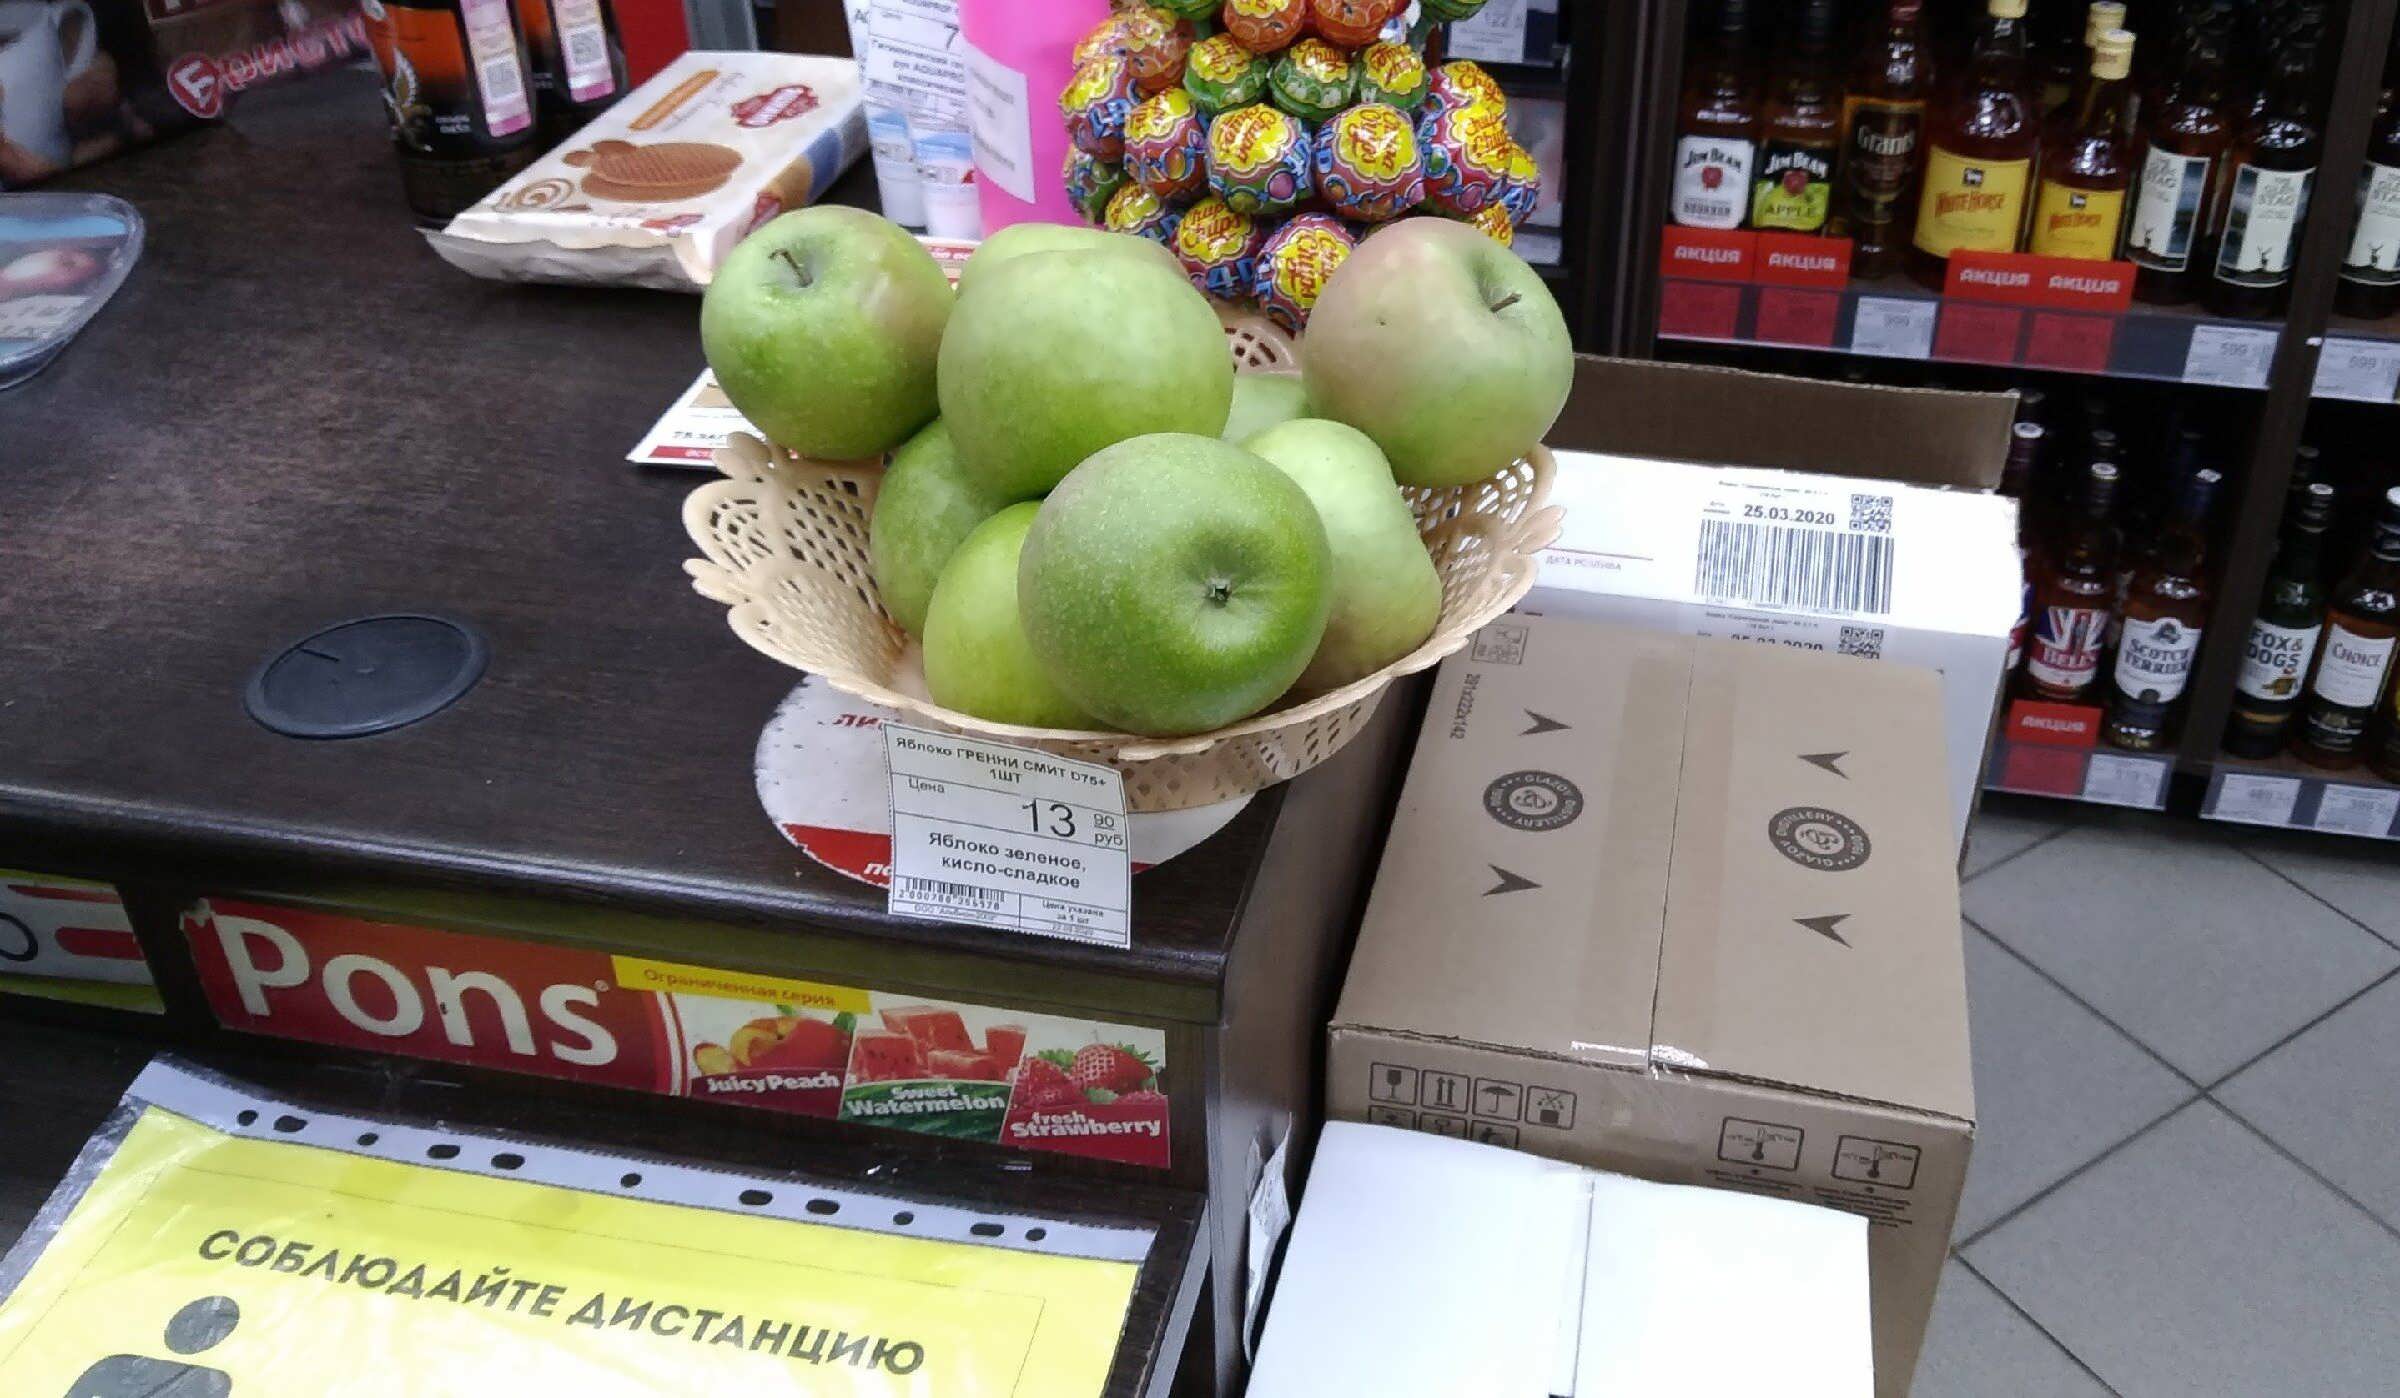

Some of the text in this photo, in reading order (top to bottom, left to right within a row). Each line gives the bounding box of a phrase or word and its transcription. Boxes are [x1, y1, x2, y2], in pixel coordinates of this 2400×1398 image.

[1673, 245, 1742, 264] АКЦИЯ
[1768, 252, 1836, 271] АКЦИЯ
[1959, 267, 2030, 287] АКЦИЯ
[2048, 275, 2120, 294] АКЦИЯ
[1744, 504, 1835, 525] 25.03.2020
[2249, 644, 2300, 668] DOGS
[896, 737, 952, 756] Яблоко
[956, 747, 1019, 769] ГРЕННИ
[1023, 759, 1066, 778] СМИТ
[908, 777, 945, 794] Цена
[989, 768, 1021, 784] 1ШТ
[1021, 798, 1077, 838] 13
[1093, 813, 1115, 829] 90
[1093, 832, 1124, 847] руб
[929, 832, 1087, 872] Яблоко зеленое,
[941, 857, 1080, 889] кисло-сладкое
[207, 913, 619, 1067] Pons
[643, 968, 836, 1007] Ограниченная серия
[846, 1097, 1005, 1117] Watermelon
[1032, 1110, 1087, 1124] fresh
[1010, 1116, 1162, 1138] Strawberry
[200, 1228, 924, 1376] СОБЛЮДАЙТЕ ДИСТАНЦИЮ
